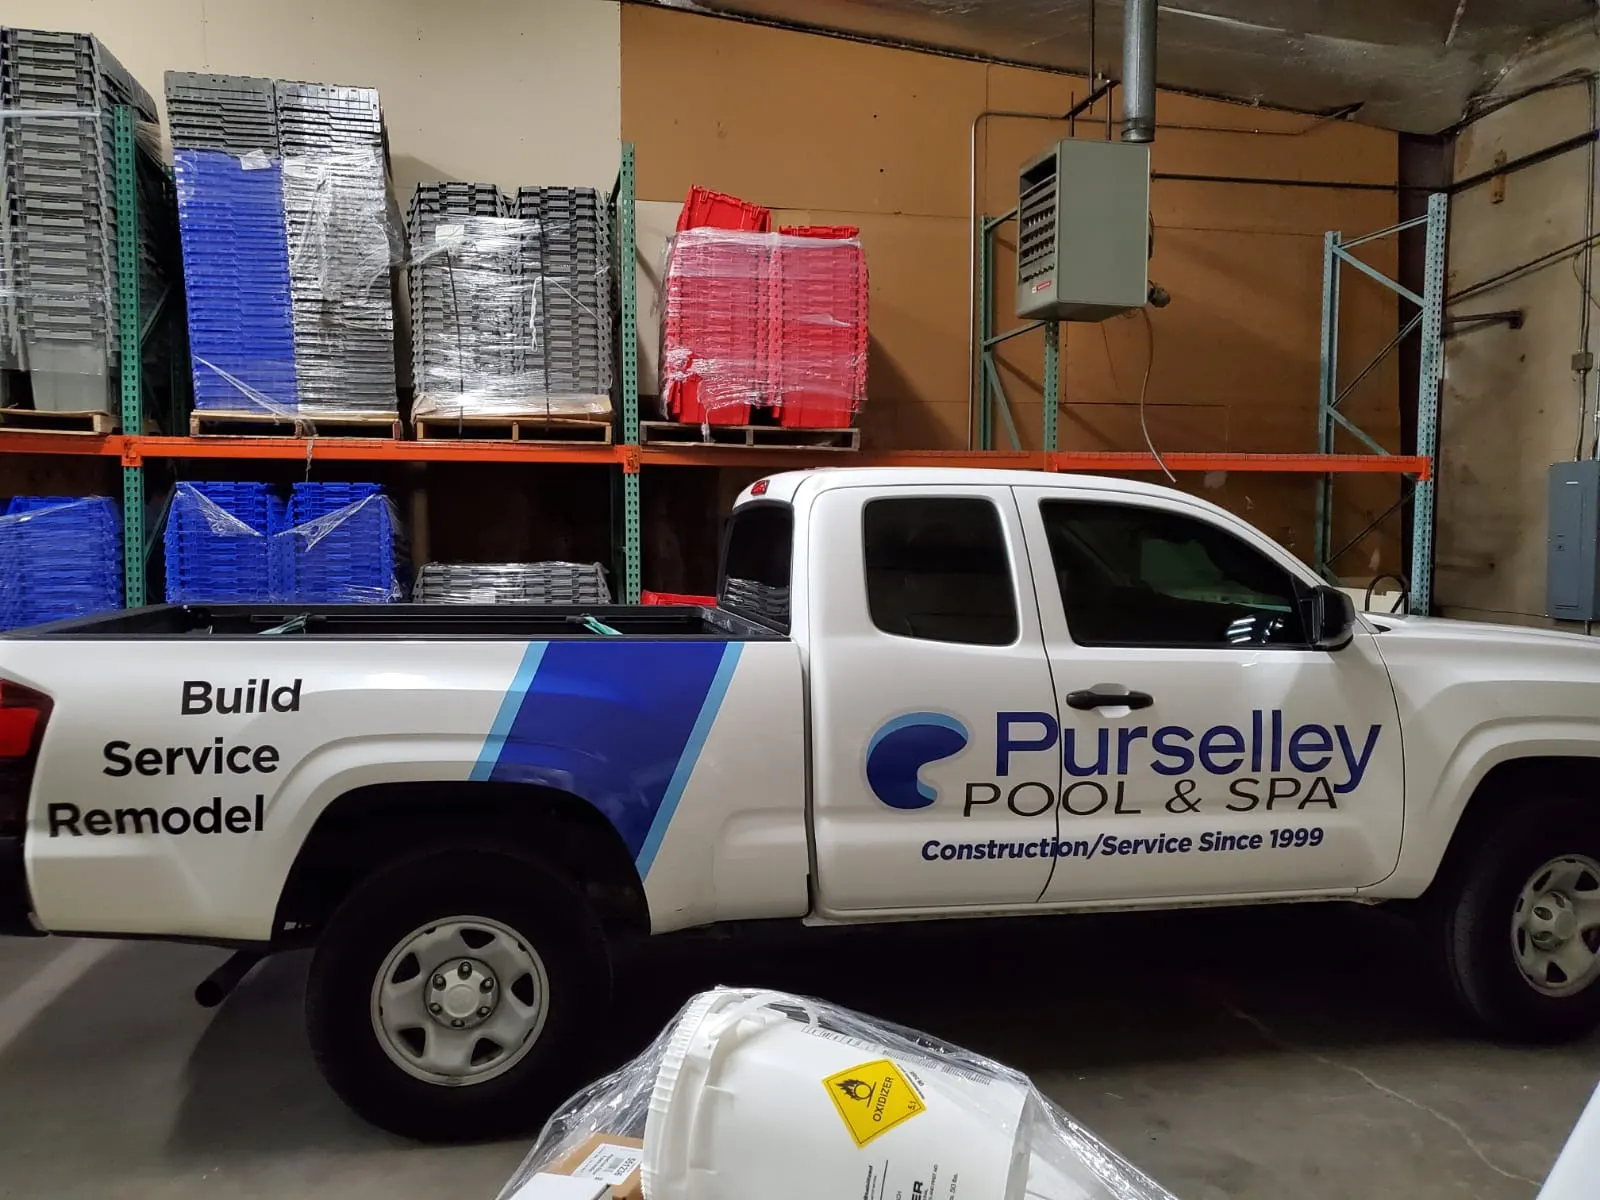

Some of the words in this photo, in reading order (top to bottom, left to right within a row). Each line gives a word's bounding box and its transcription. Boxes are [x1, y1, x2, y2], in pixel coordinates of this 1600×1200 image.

[181, 678, 303, 716] Build
[103, 736, 280, 778] Service
[996, 709, 1382, 794] Purselley
[49, 793, 265, 838] Remodel
[963, 780, 1142, 818] POOL
[1165, 778, 1202, 813] &
[1225, 777, 1339, 812] SPA
[921, 833, 1193, 862] Construction/Service
[1197, 830, 1263, 853] Since
[1269, 827, 1325, 849] 1999
[872, 1076, 894, 1122] OXIDIZER
